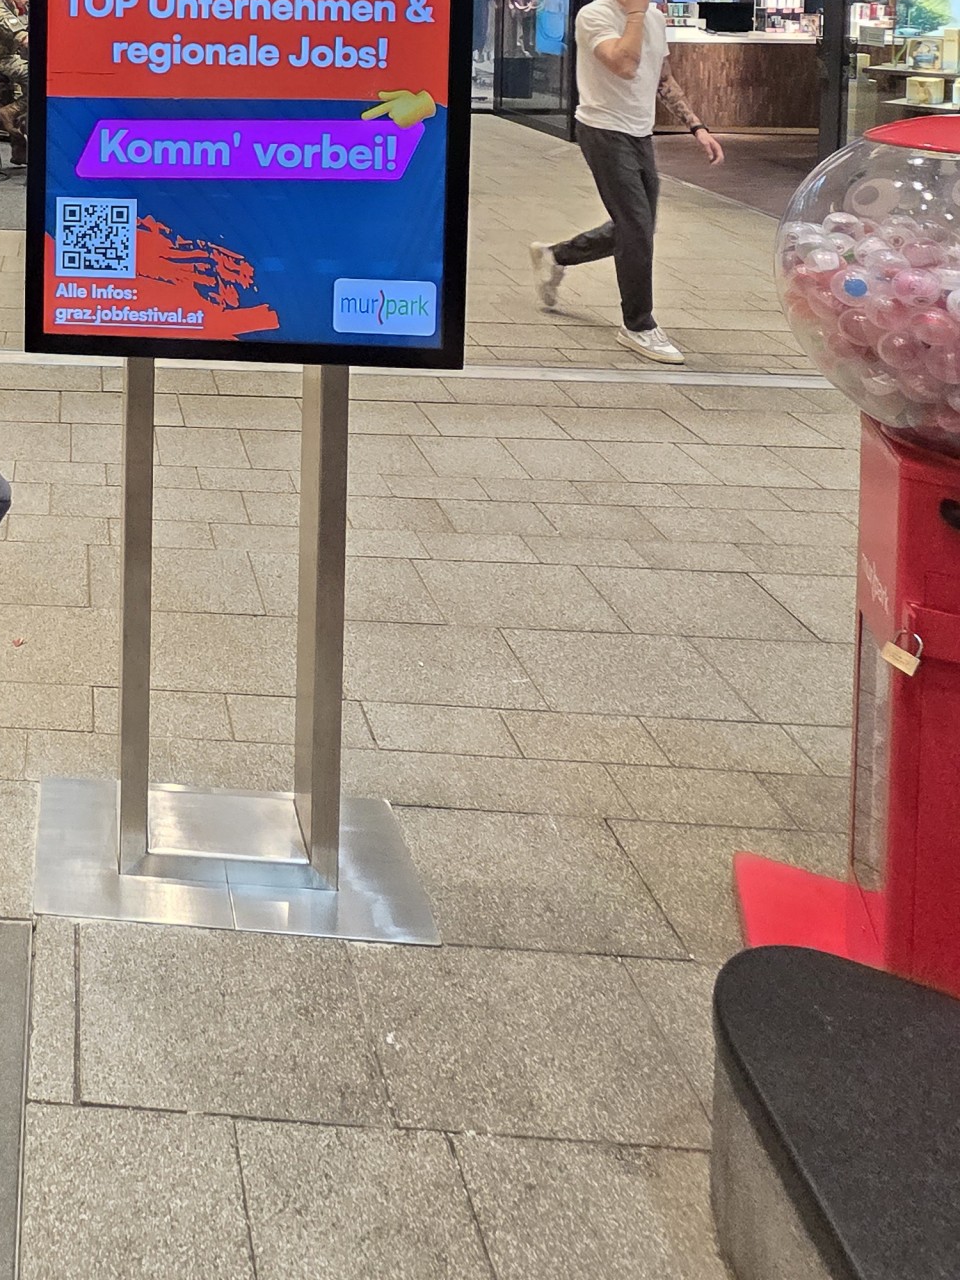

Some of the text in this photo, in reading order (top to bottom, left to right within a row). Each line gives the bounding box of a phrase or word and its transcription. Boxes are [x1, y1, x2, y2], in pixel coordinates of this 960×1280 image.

[112, 34, 388, 74] regionale Jobs!
[100, 128, 397, 170] Komm' vorbei!
[55, 284, 138, 301] Alle Infos:
[55, 307, 204, 326] graz.jobfestival.at
